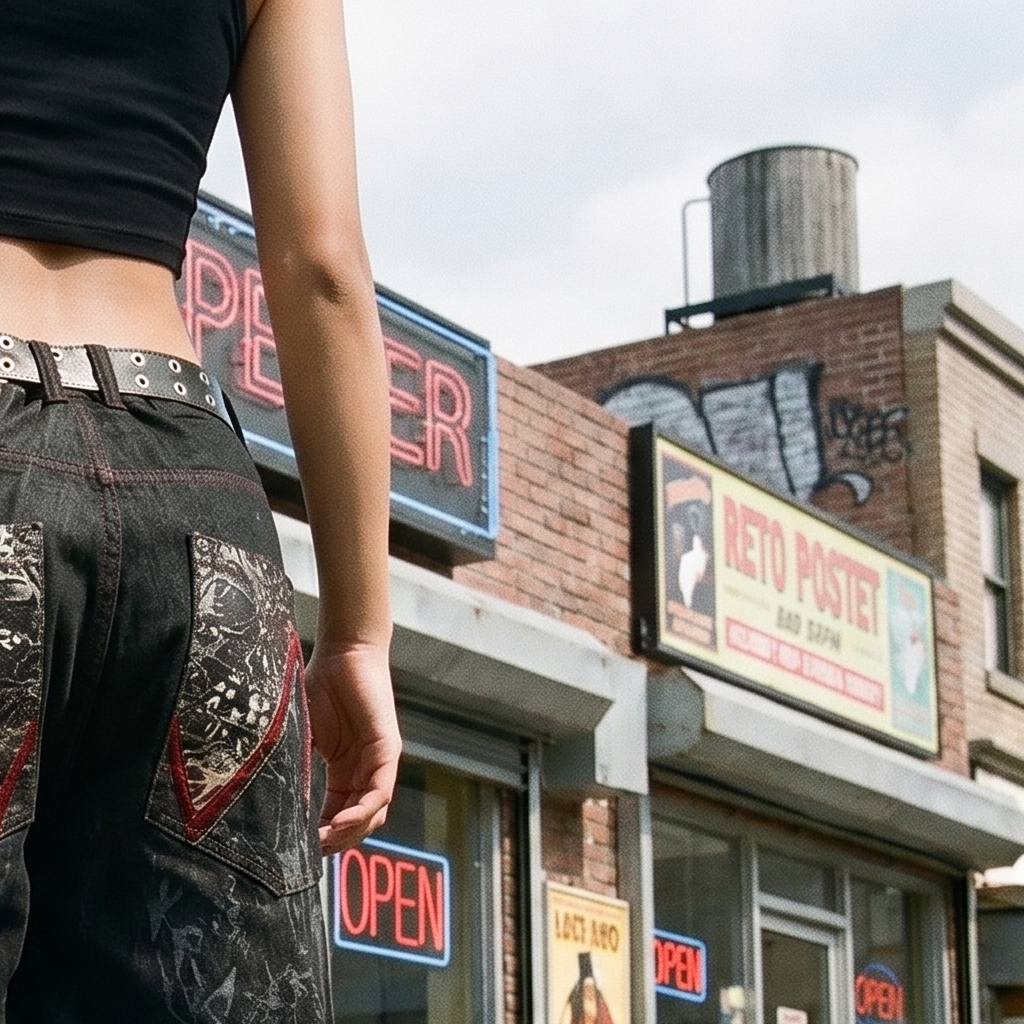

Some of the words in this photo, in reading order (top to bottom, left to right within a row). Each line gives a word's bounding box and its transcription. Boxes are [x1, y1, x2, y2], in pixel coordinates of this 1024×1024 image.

[722, 495, 787, 593] RETO
[340, 847, 445, 952] OPEN
[854, 973, 905, 1022] OPEN
